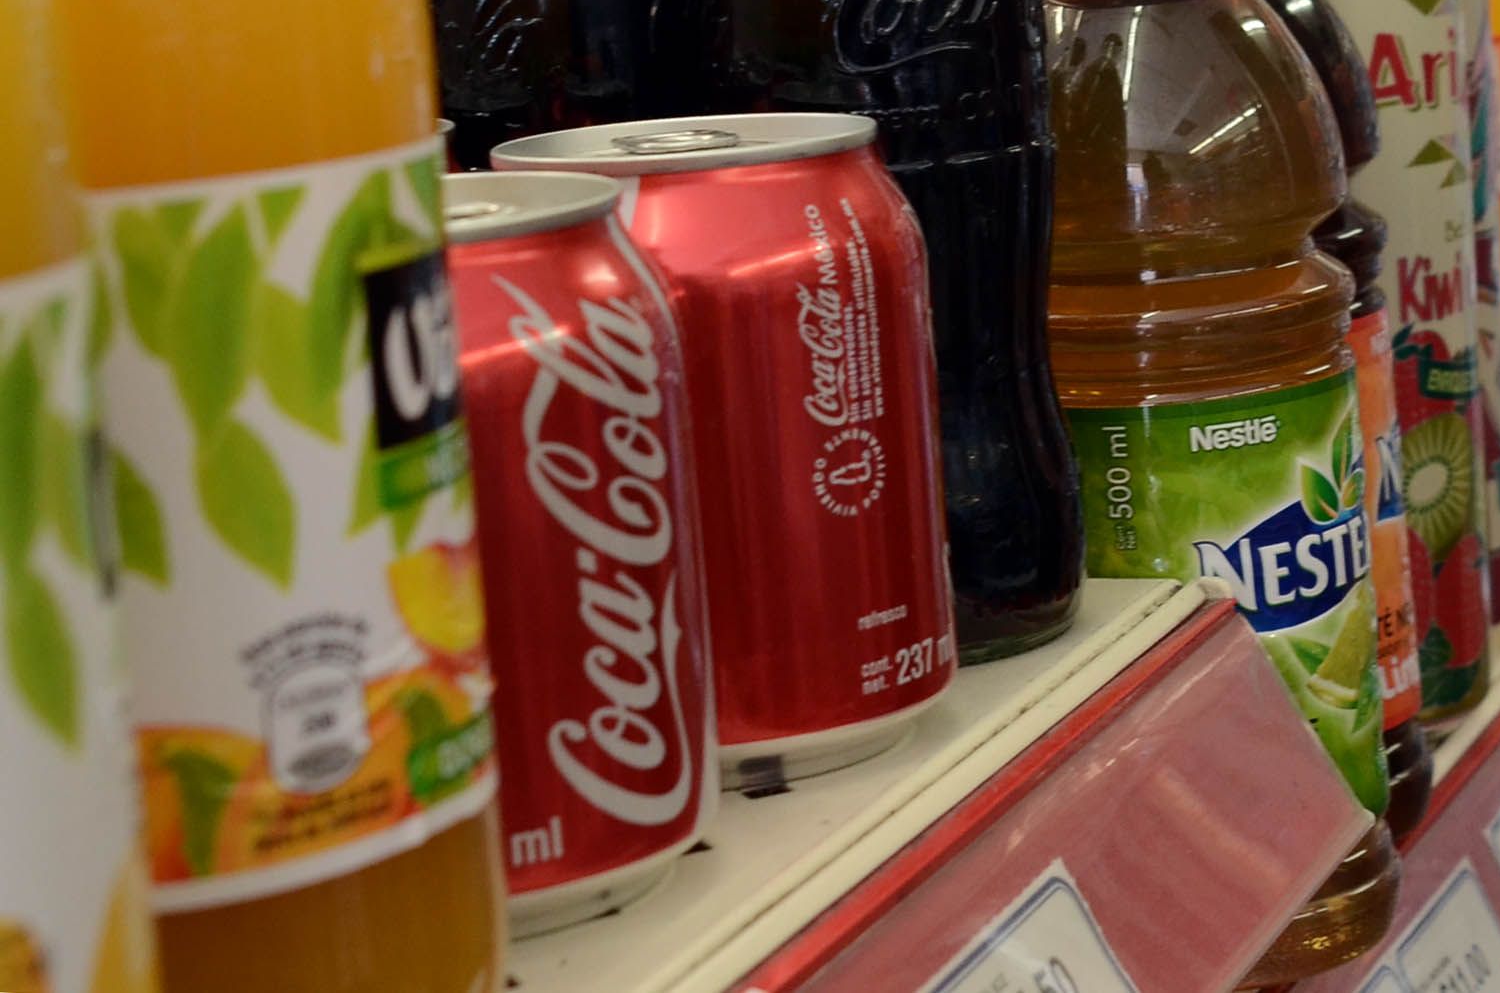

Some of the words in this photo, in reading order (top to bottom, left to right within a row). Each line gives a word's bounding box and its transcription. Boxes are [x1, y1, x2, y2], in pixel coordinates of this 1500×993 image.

[1397, 253, 1464, 323] Kiwi
[1102, 426, 1127, 458] ml
[1189, 415, 1278, 453] Nestlé
[1106, 467, 1134, 519] 500
[492, 271, 692, 826] Coca-Cola
[895, 637, 934, 686] 237
[511, 817, 564, 867] ml
